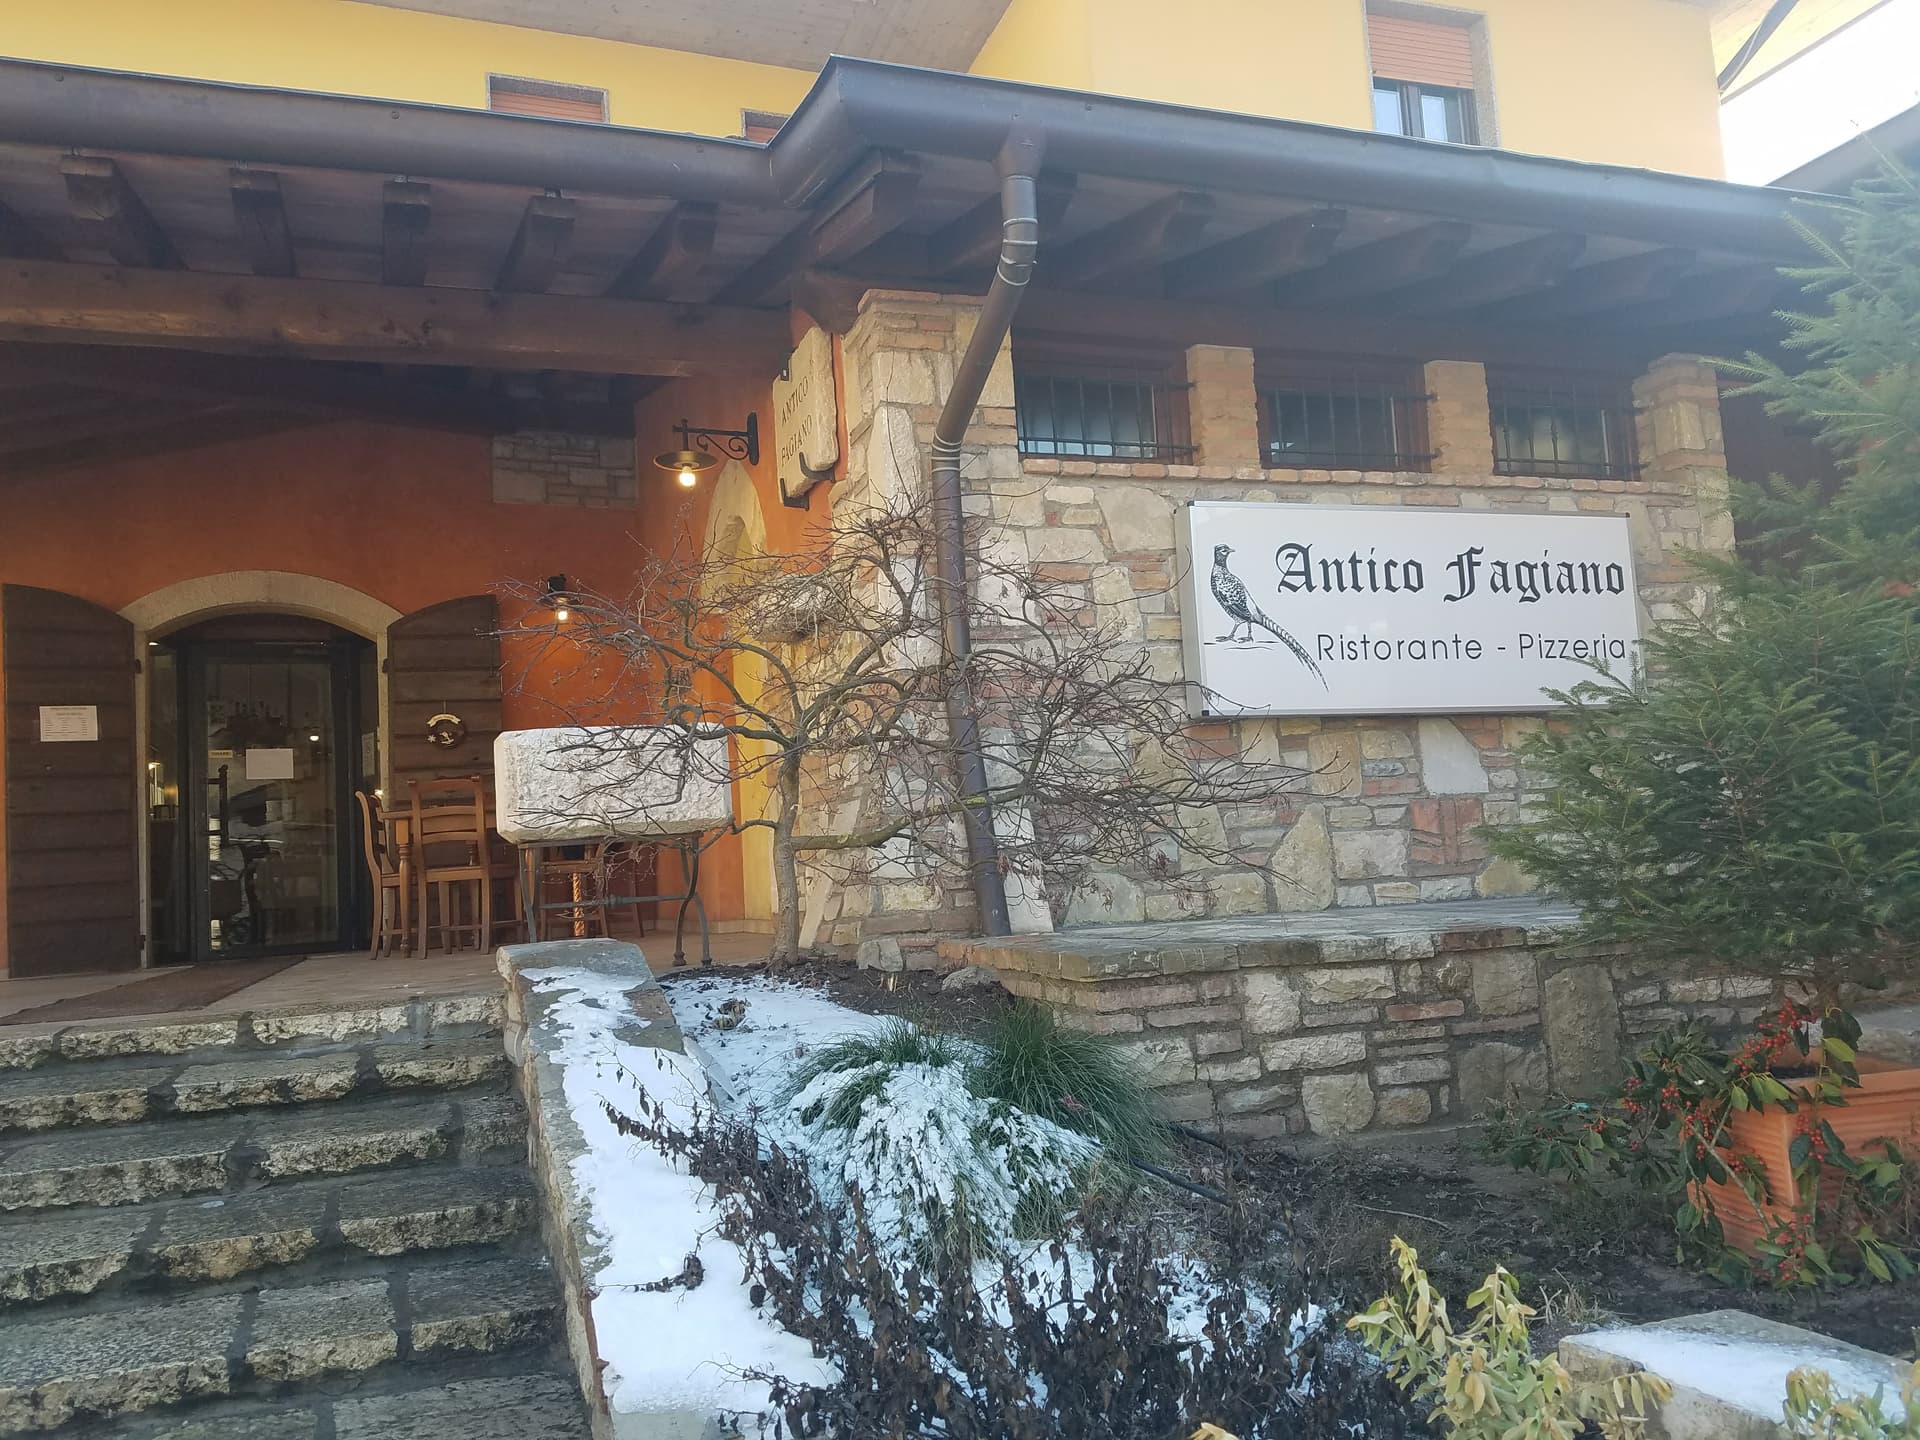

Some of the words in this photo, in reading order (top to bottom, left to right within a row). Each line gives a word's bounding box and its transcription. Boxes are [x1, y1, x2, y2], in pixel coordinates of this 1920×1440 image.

[782, 376, 808, 427] ANTICO
[781, 414, 812, 467] FAGIANO
[1275, 542, 1425, 594] Antico
[1443, 545, 1626, 604] Fagiano
[1316, 633, 1484, 661] Ristorante
[1519, 633, 1626, 659] Pizzeria
